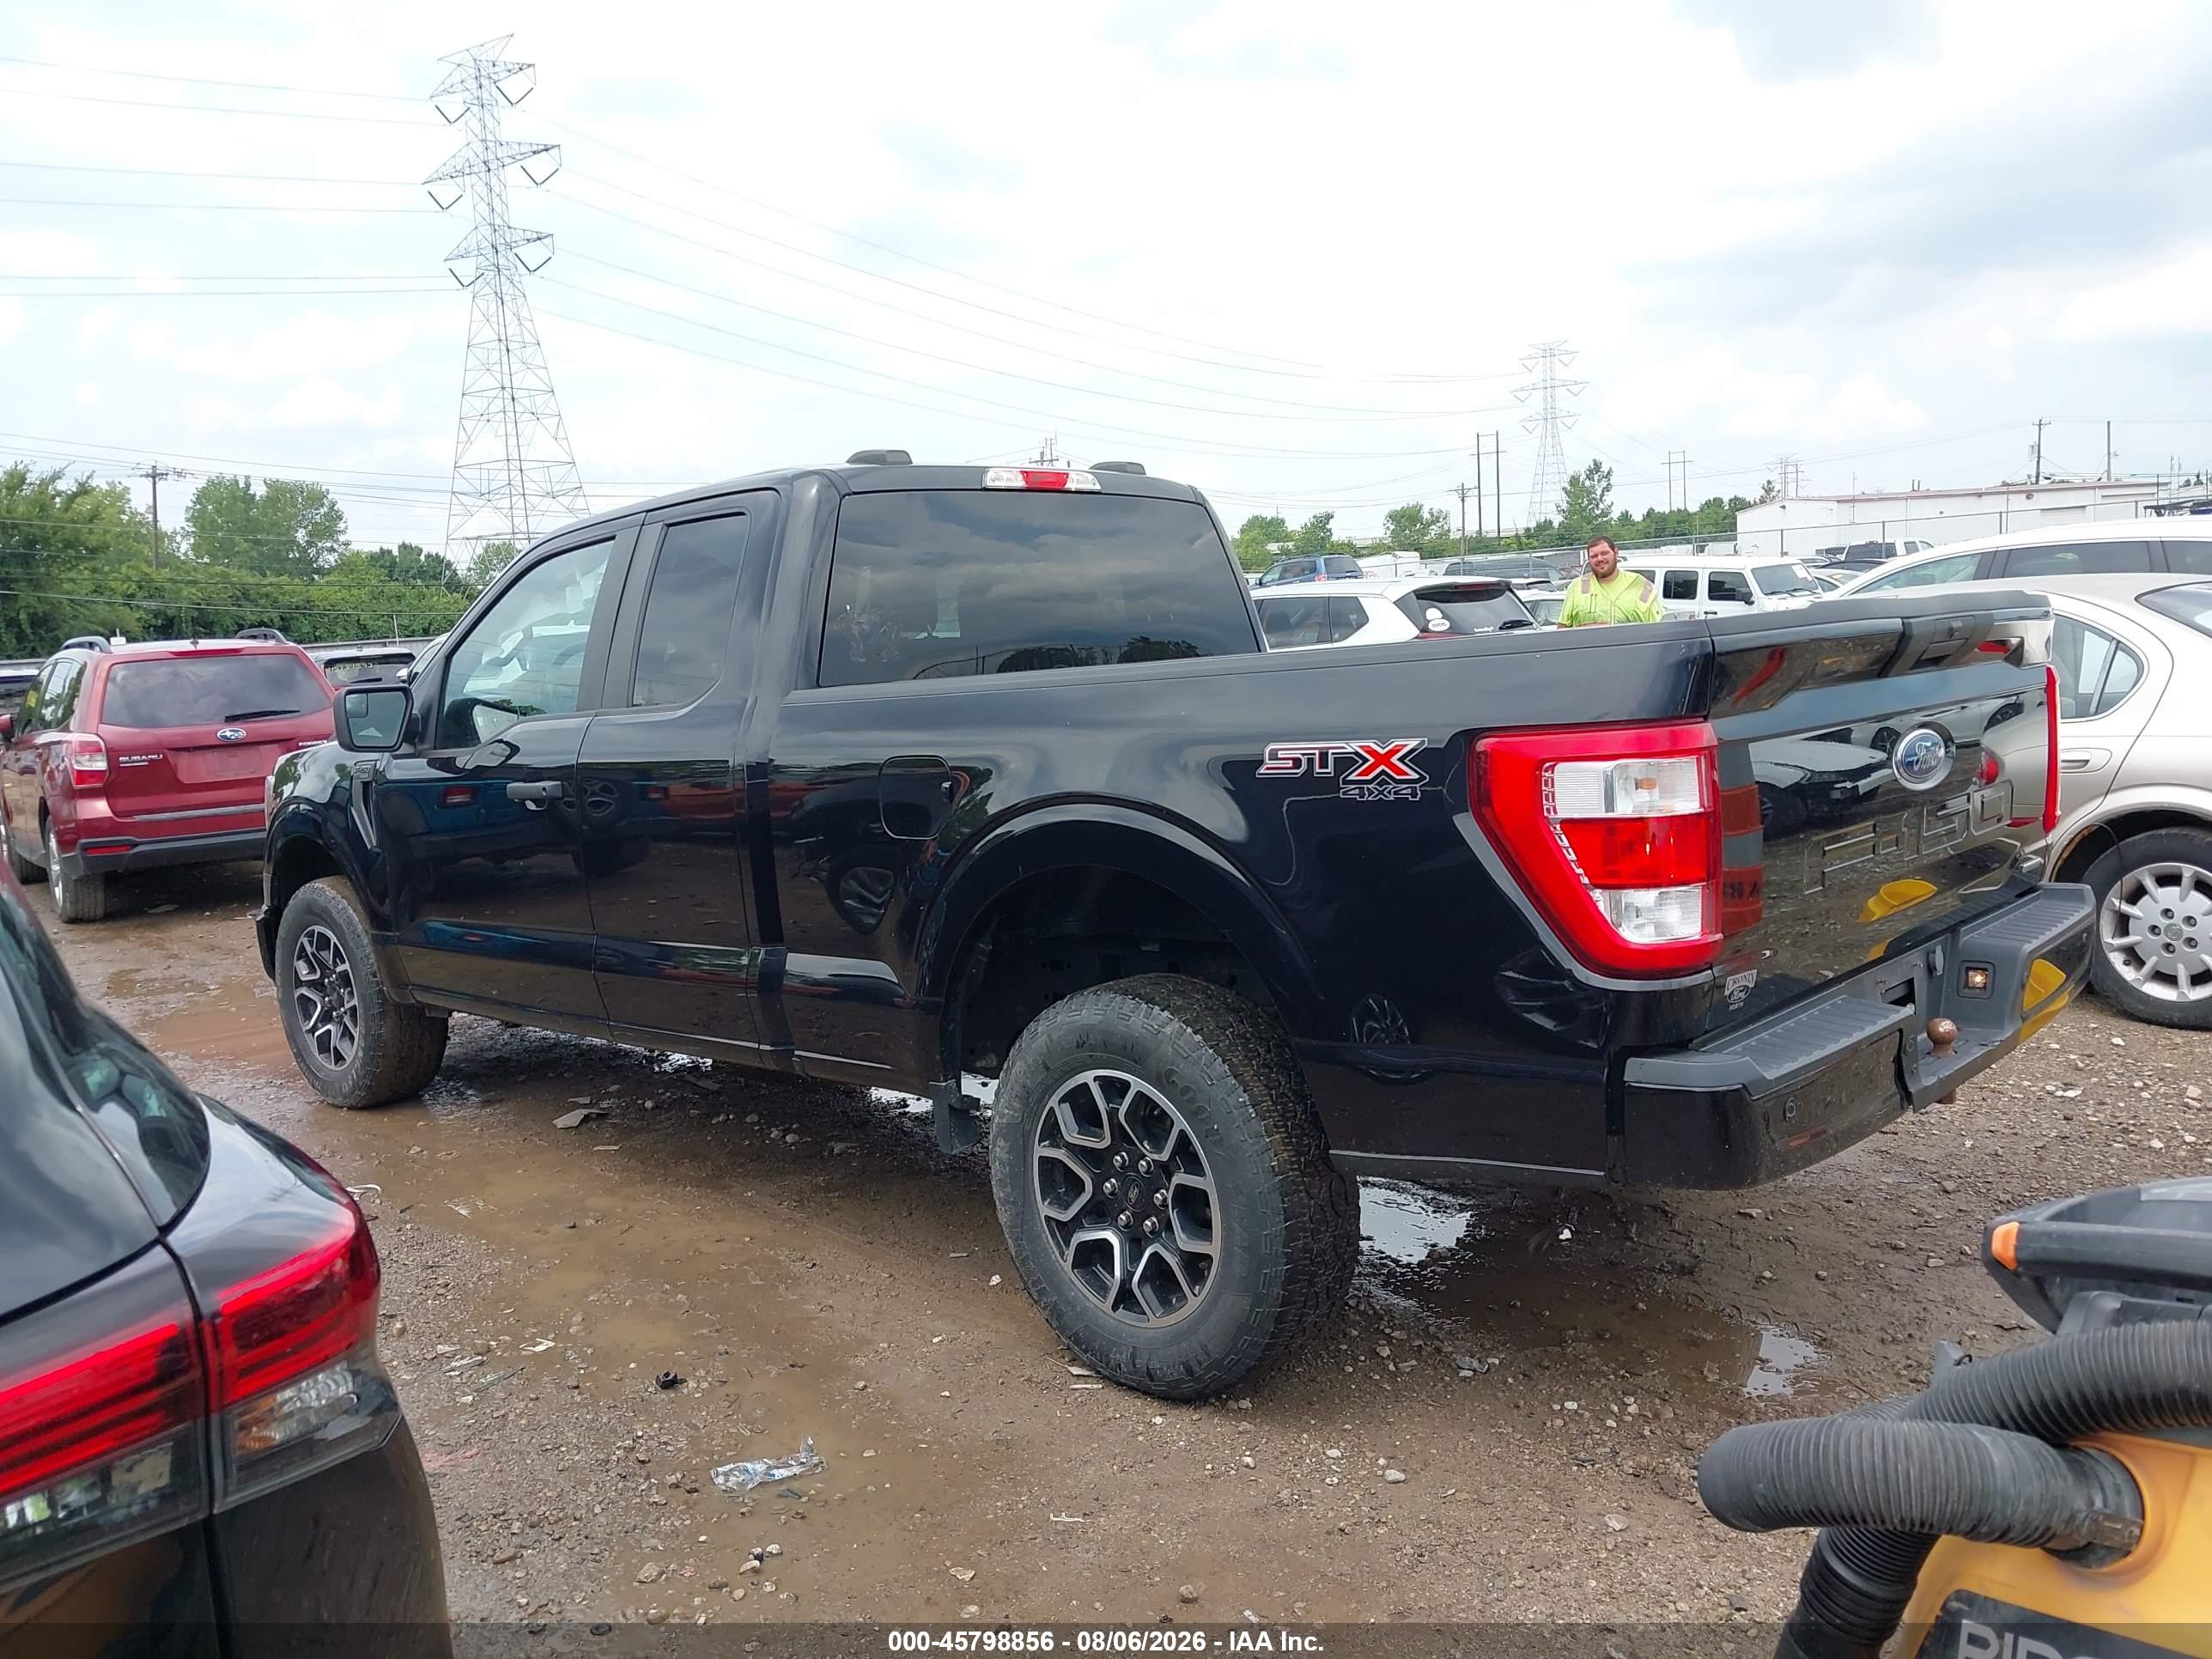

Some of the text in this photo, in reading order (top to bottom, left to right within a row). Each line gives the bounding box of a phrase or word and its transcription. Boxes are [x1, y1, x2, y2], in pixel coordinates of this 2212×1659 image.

[118, 754, 163, 763] SUBARU
[1256, 738, 1429, 787] STX
[1905, 740, 1943, 772] Ford
[1726, 969, 1756, 991] CRONIN
